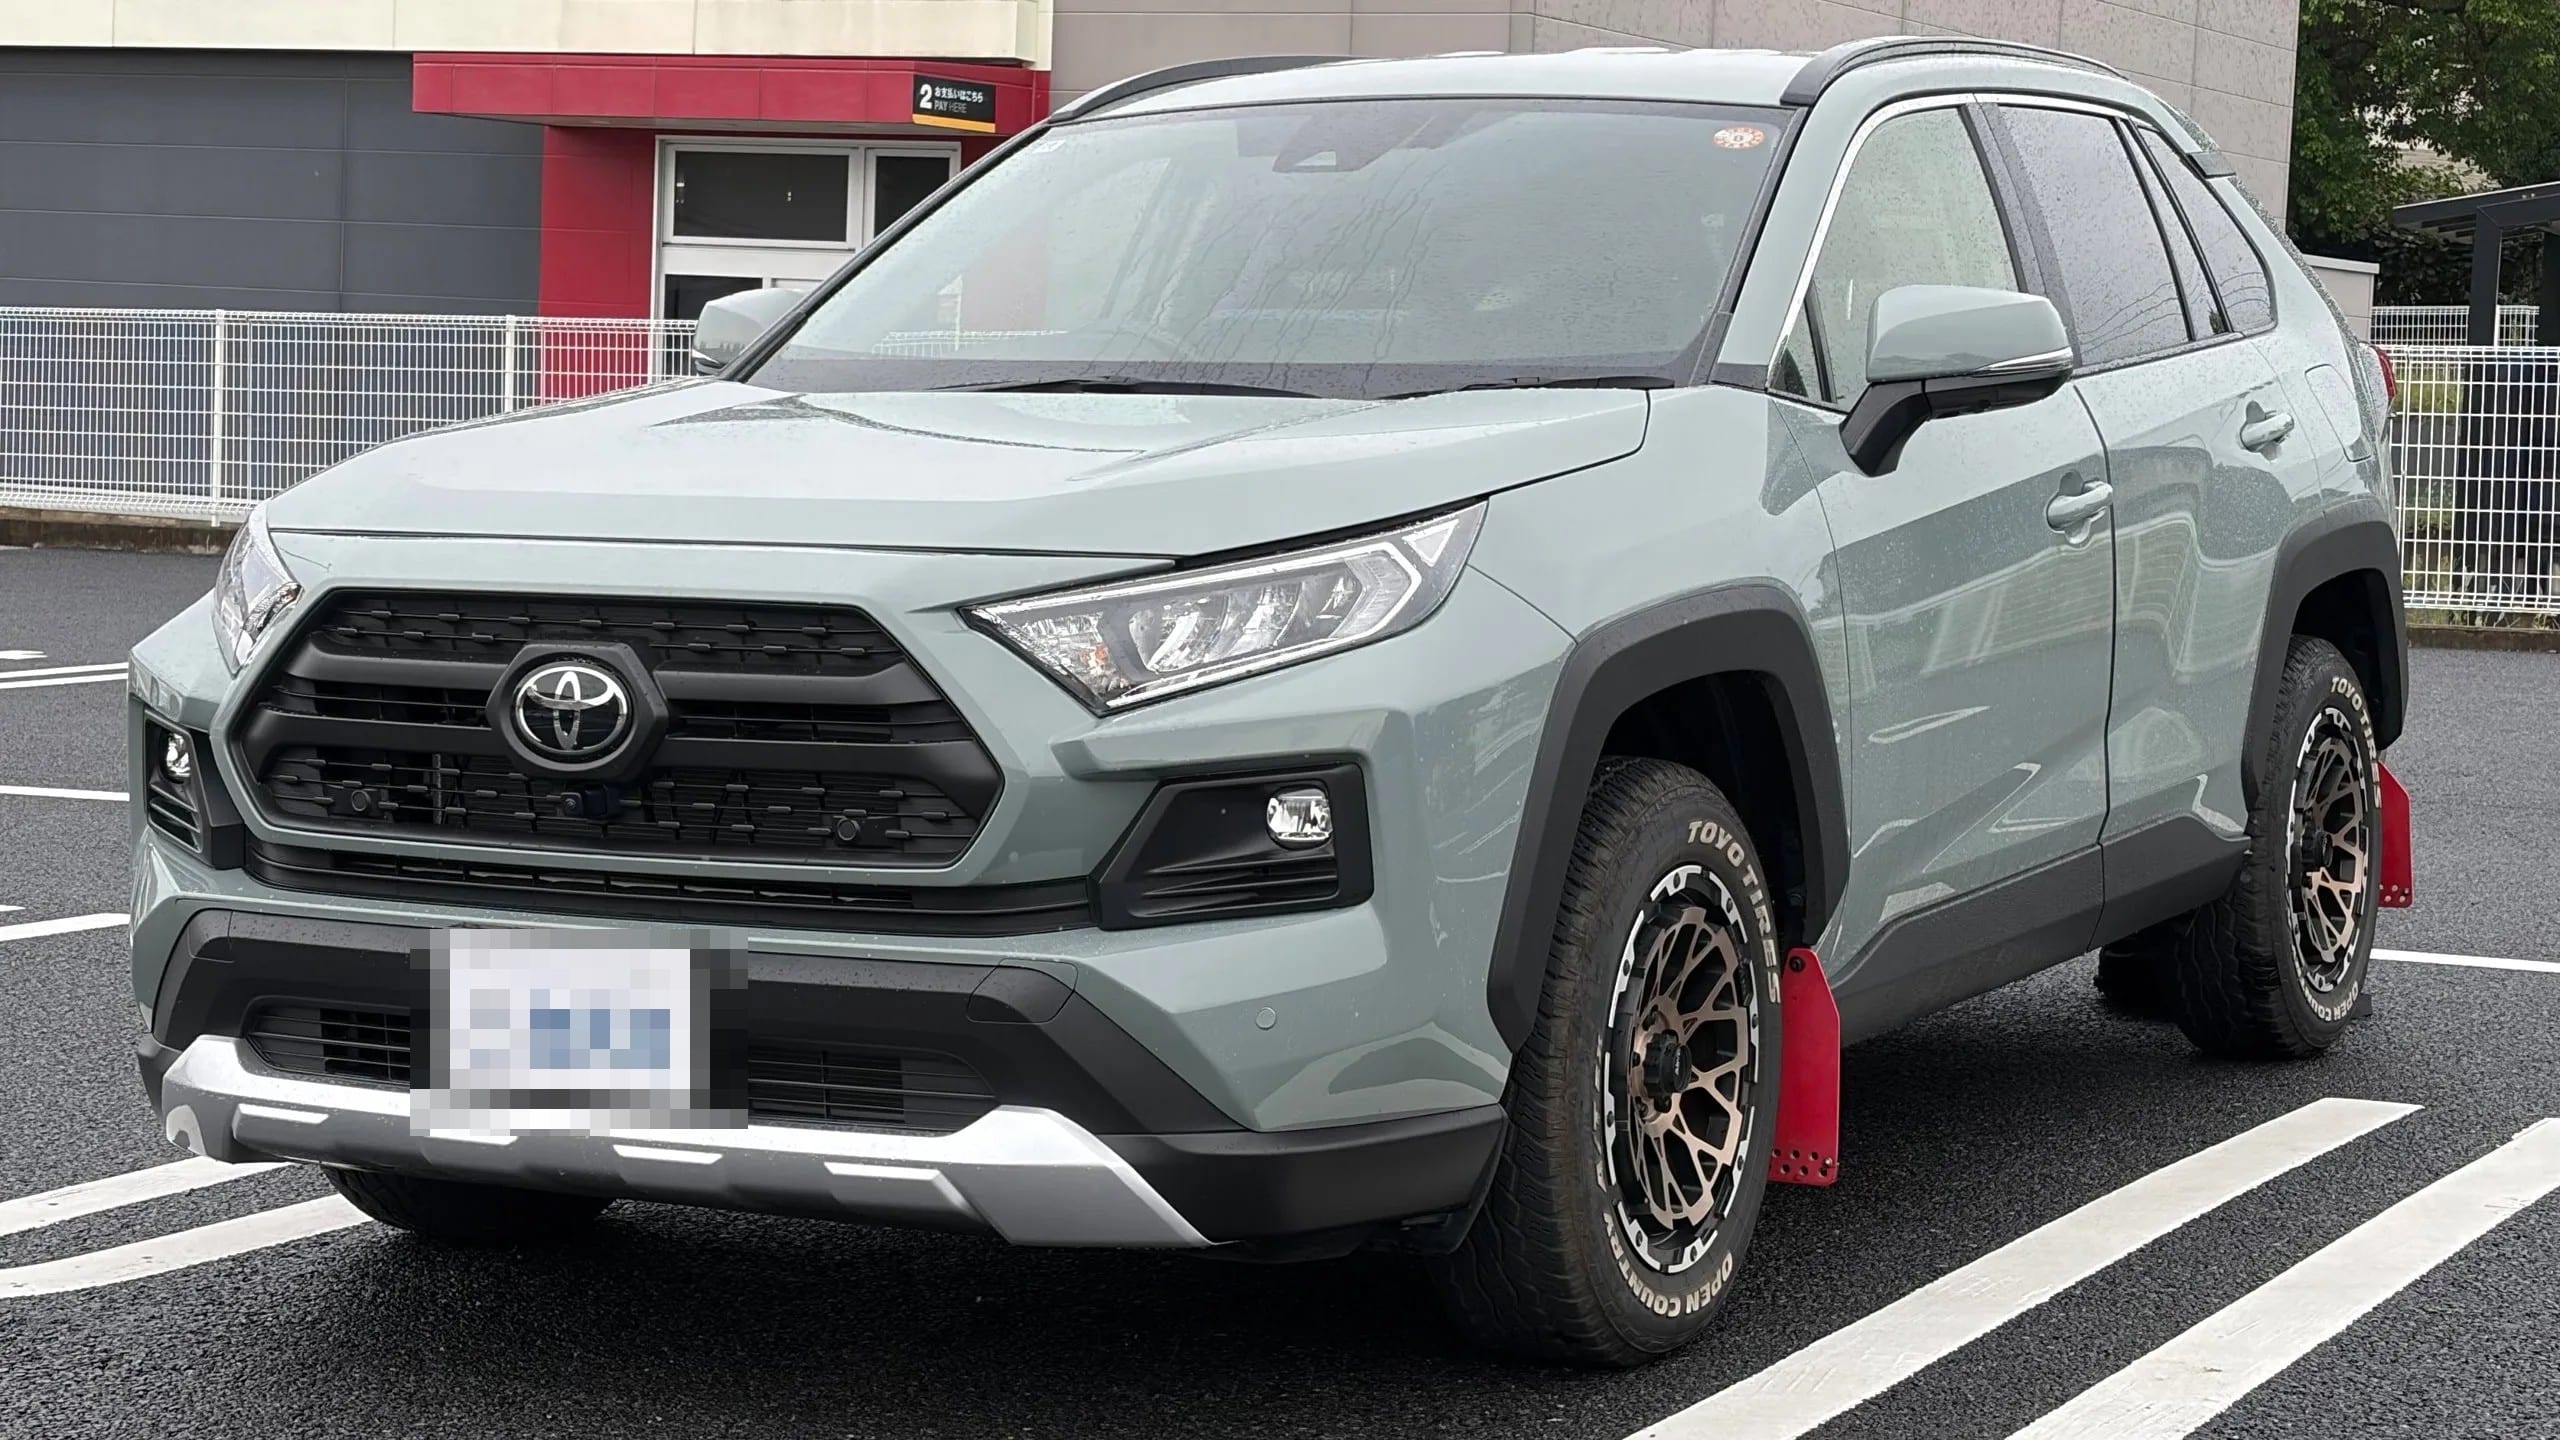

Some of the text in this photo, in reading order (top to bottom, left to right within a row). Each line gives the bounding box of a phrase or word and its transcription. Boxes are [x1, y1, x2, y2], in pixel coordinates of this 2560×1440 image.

[920, 83, 932, 109] 2
[934, 86, 984, 103] お支払いはこちら
[934, 100, 948, 112] PAY
[2331, 676, 2382, 809] TOYO TIRES
[1687, 821, 1781, 1003] TOYO TIRES
[2334, 980, 2359, 1021] OPEN
[1603, 1212, 1681, 1317] COUNTRY
[1686, 1252, 1733, 1314] OPEN
